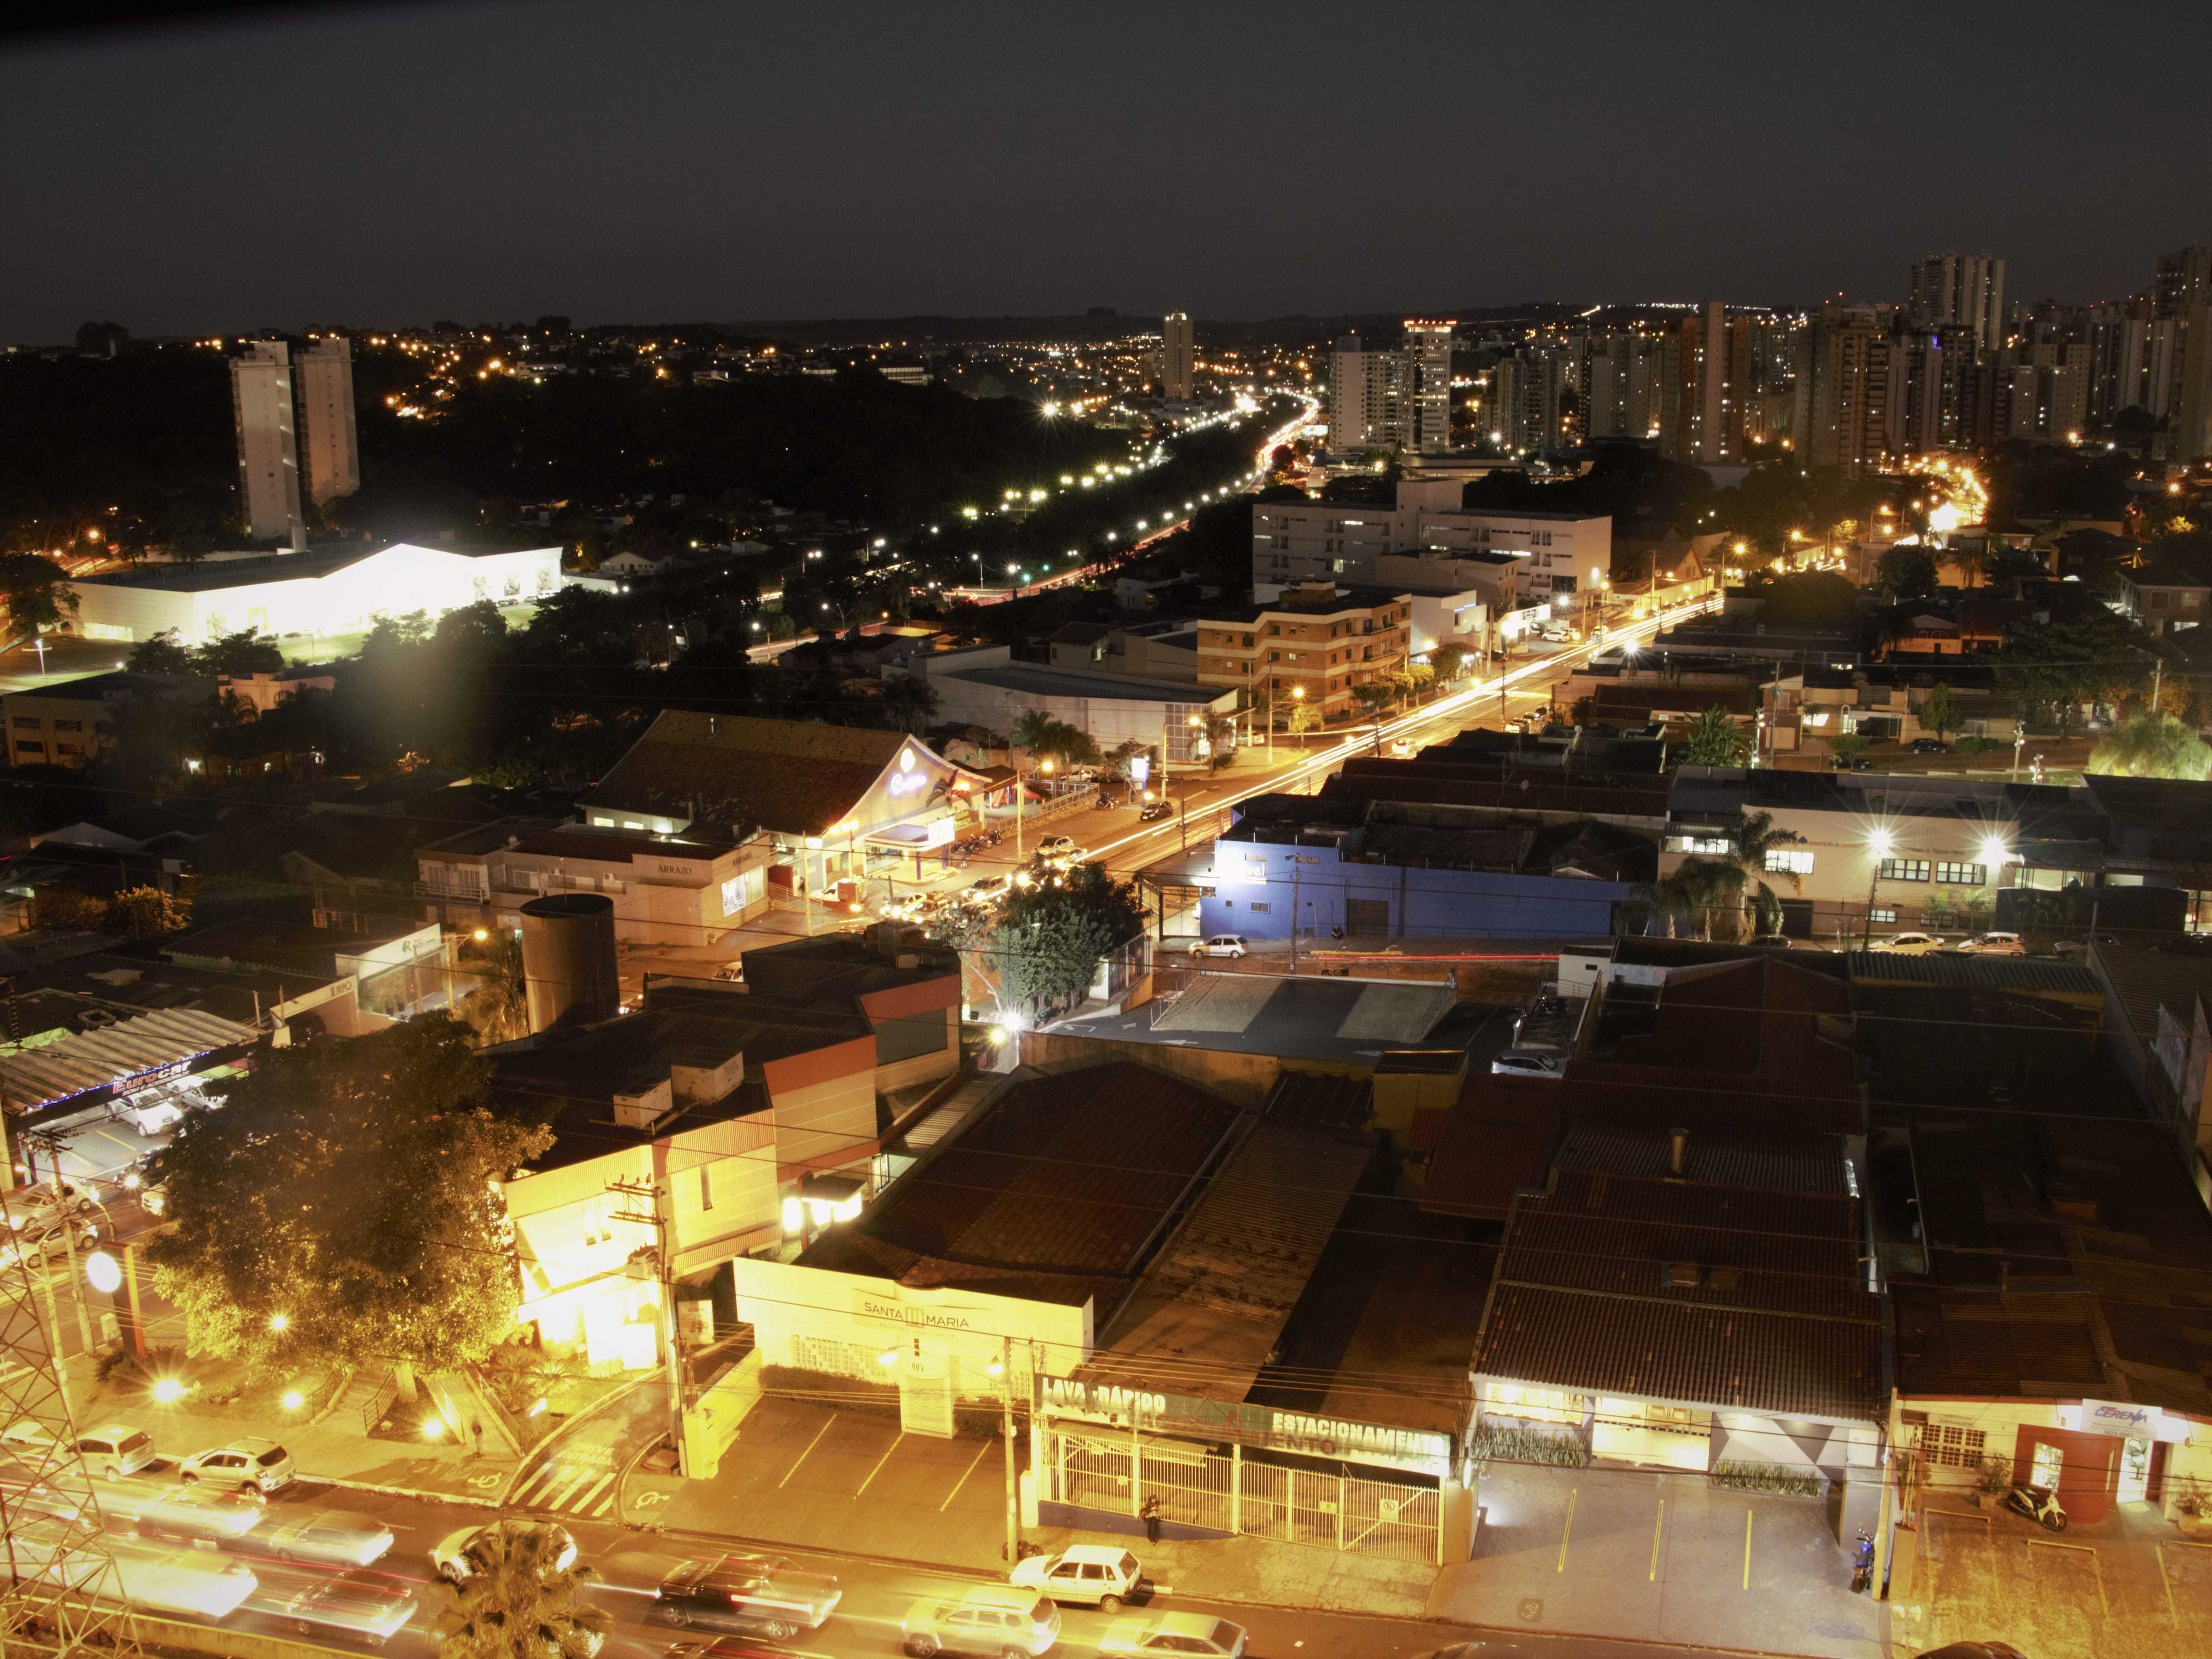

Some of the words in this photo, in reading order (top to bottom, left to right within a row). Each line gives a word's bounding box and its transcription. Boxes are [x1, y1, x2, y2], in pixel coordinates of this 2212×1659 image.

[658, 865, 692, 875] ARRAZO
[733, 852, 752, 867] ARRAZO
[113, 1061, 191, 1094] Eurocar
[865, 1302, 903, 1319] SANTA
[926, 1315, 970, 1328] MARIA
[1273, 1412, 1444, 1450] ESTACIONAMENTO
